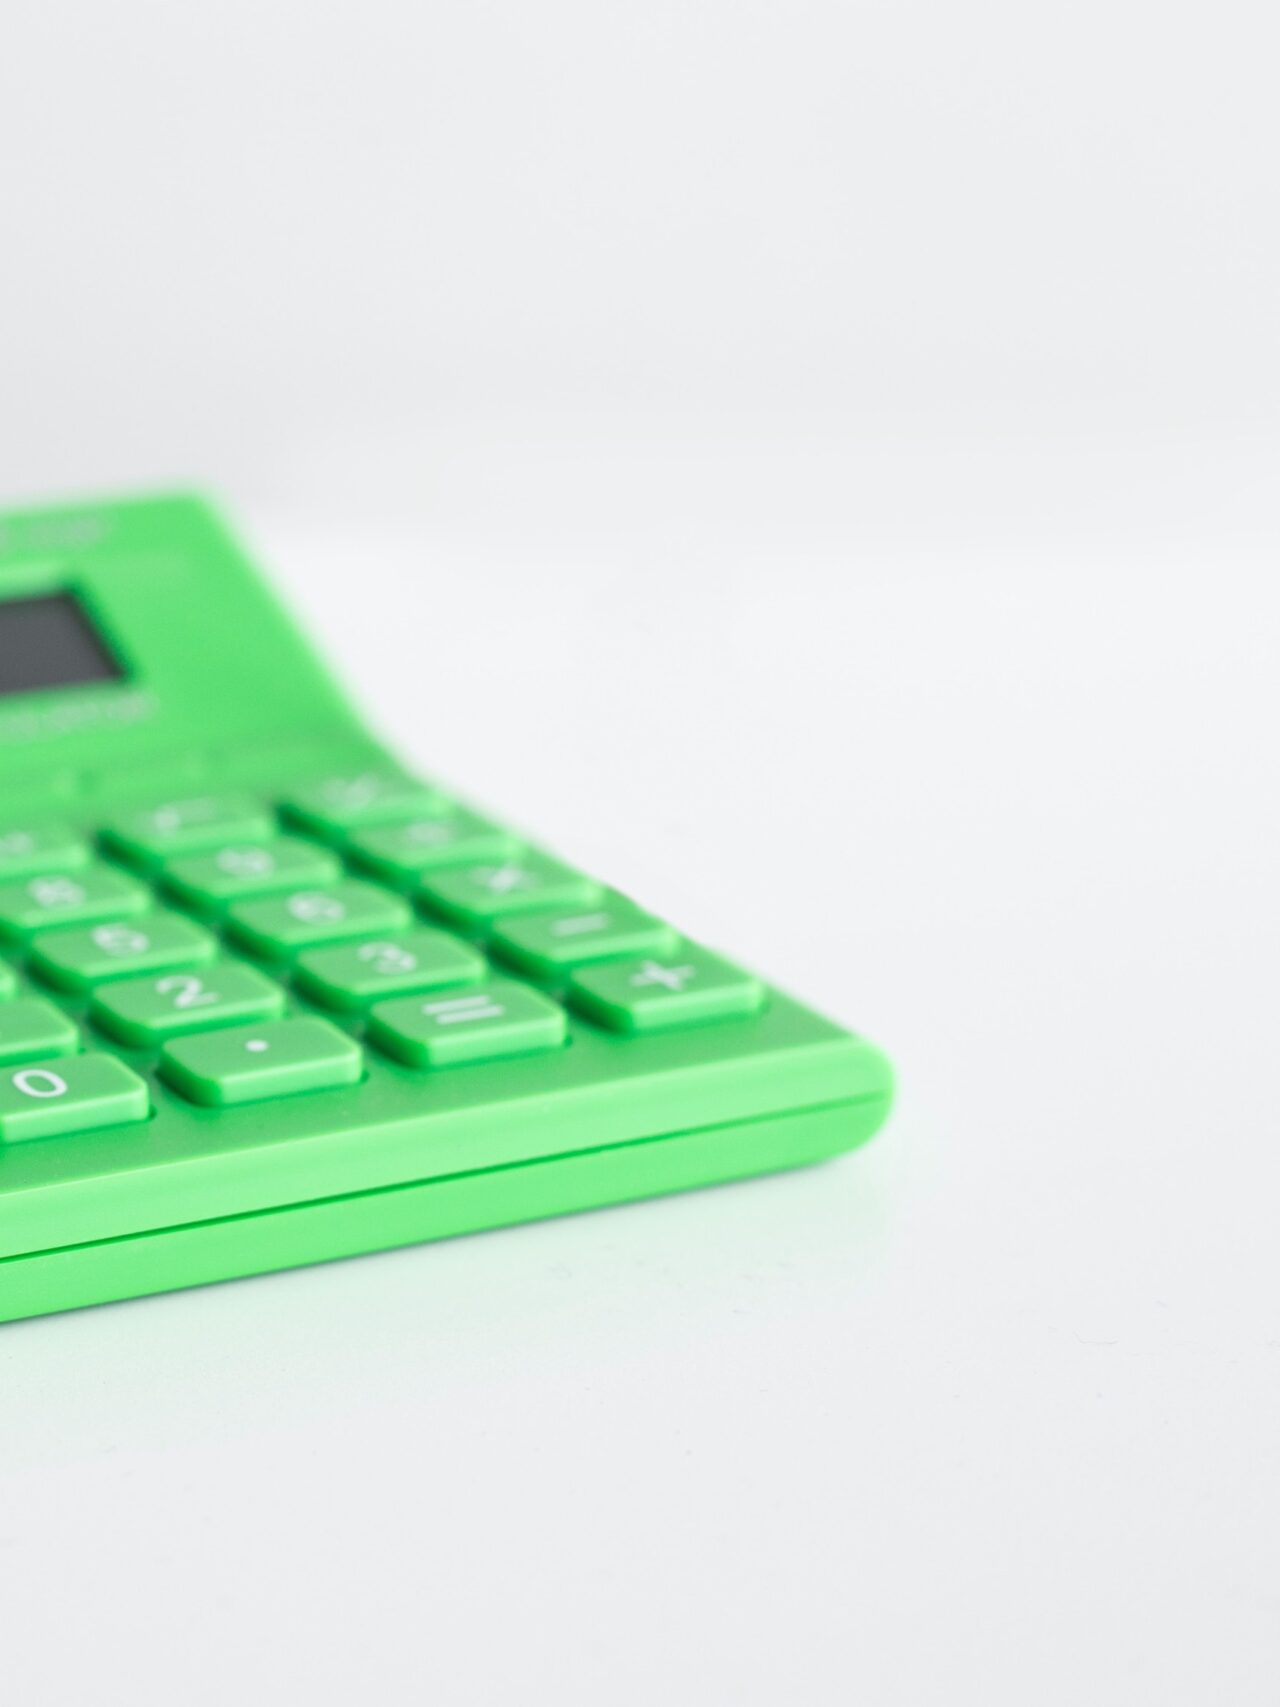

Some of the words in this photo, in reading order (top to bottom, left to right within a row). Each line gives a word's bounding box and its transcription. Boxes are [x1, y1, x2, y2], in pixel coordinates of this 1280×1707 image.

[30, 877, 86, 910] 8
[358, 942, 418, 975] 3
[156, 976, 218, 1010] 2
[12, 1068, 69, 1099] 0
